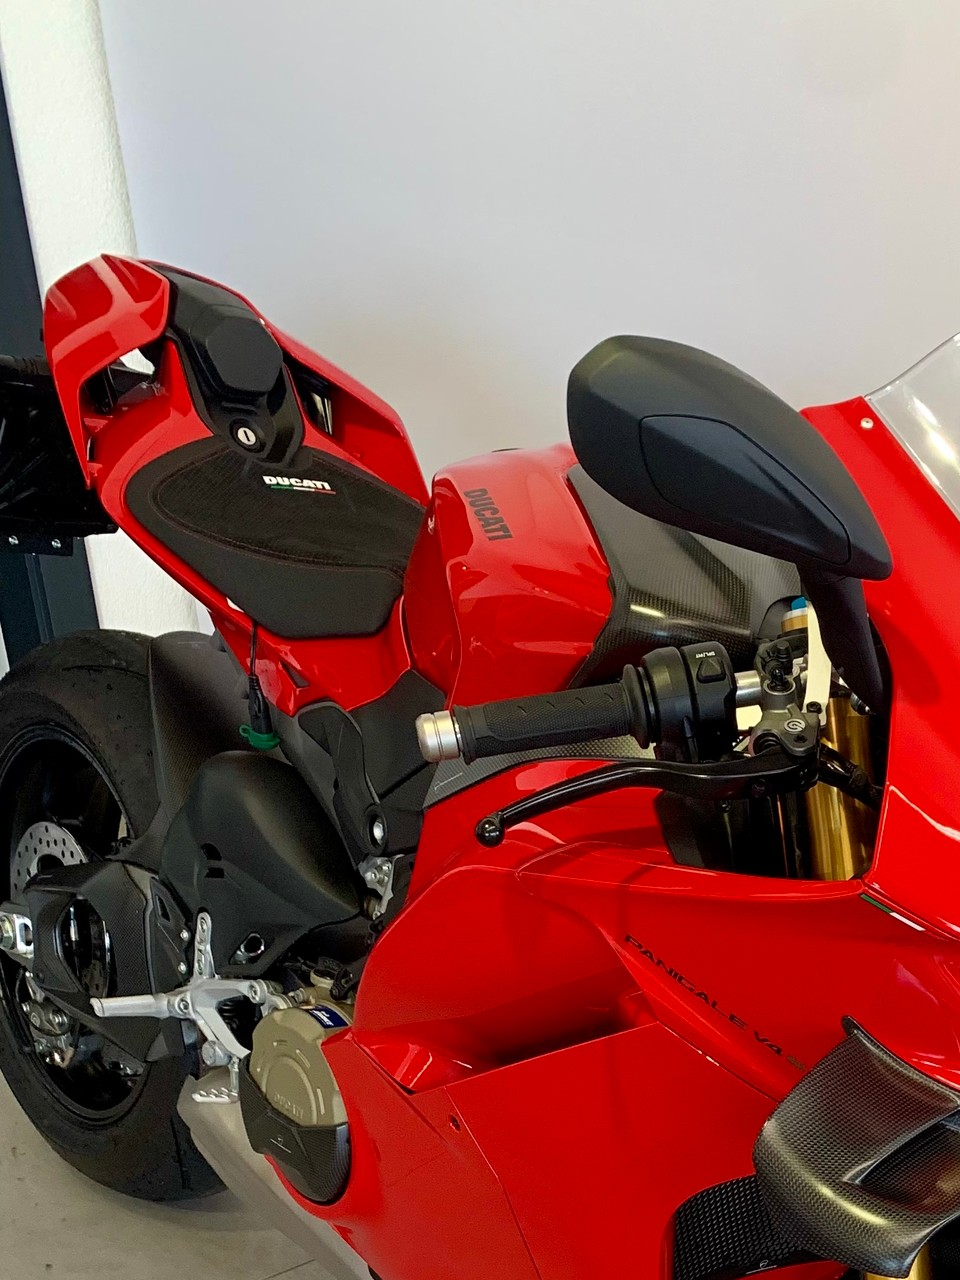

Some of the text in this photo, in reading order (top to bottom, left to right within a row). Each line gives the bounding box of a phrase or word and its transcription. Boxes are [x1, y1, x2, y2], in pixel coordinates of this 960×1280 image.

[262, 475, 331, 490] DUCATI
[463, 487, 513, 541] DUCATI
[625, 934, 748, 1032] PANIGALE
[753, 1031, 783, 1056] V4
